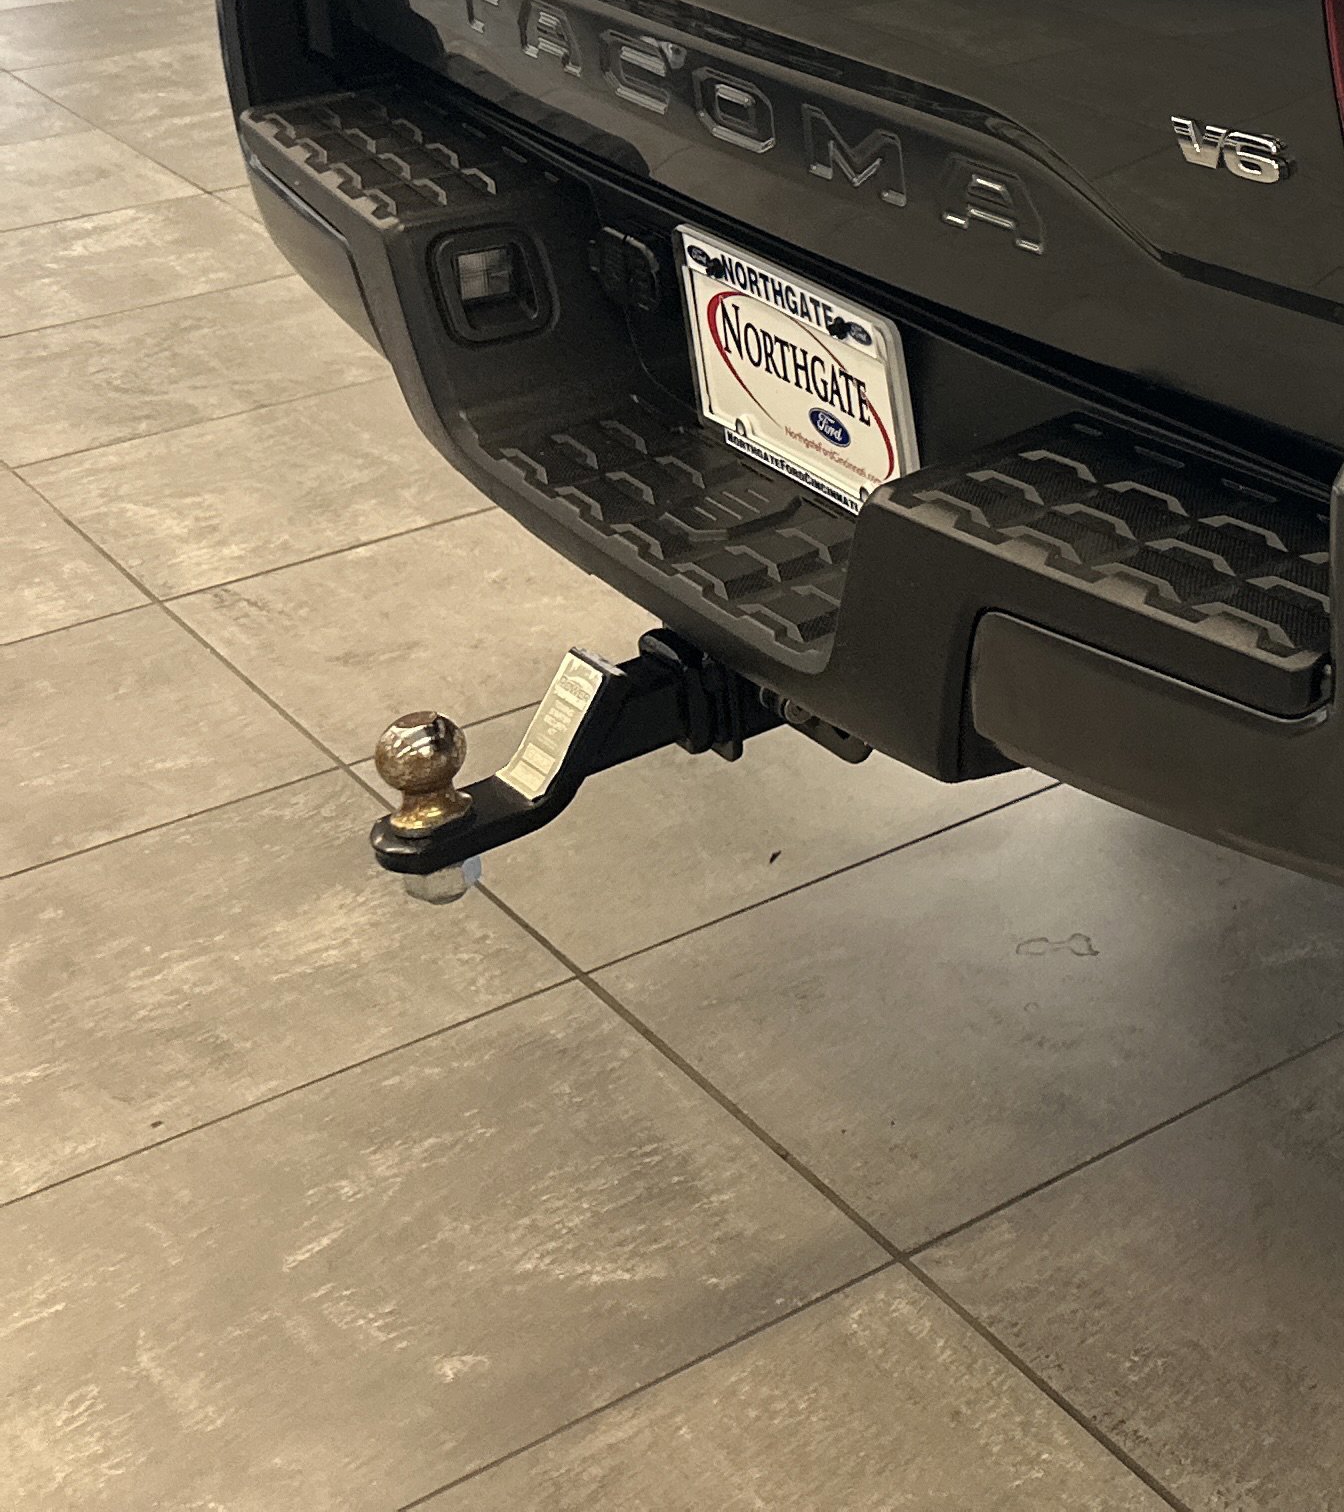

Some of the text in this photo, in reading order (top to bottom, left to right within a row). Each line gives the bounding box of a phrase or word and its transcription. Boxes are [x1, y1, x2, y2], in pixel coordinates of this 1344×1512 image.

[1170, 115, 1285, 185] V6
[720, 253, 834, 331] NORTHGATE
[720, 296, 871, 427] NORTHGATE
